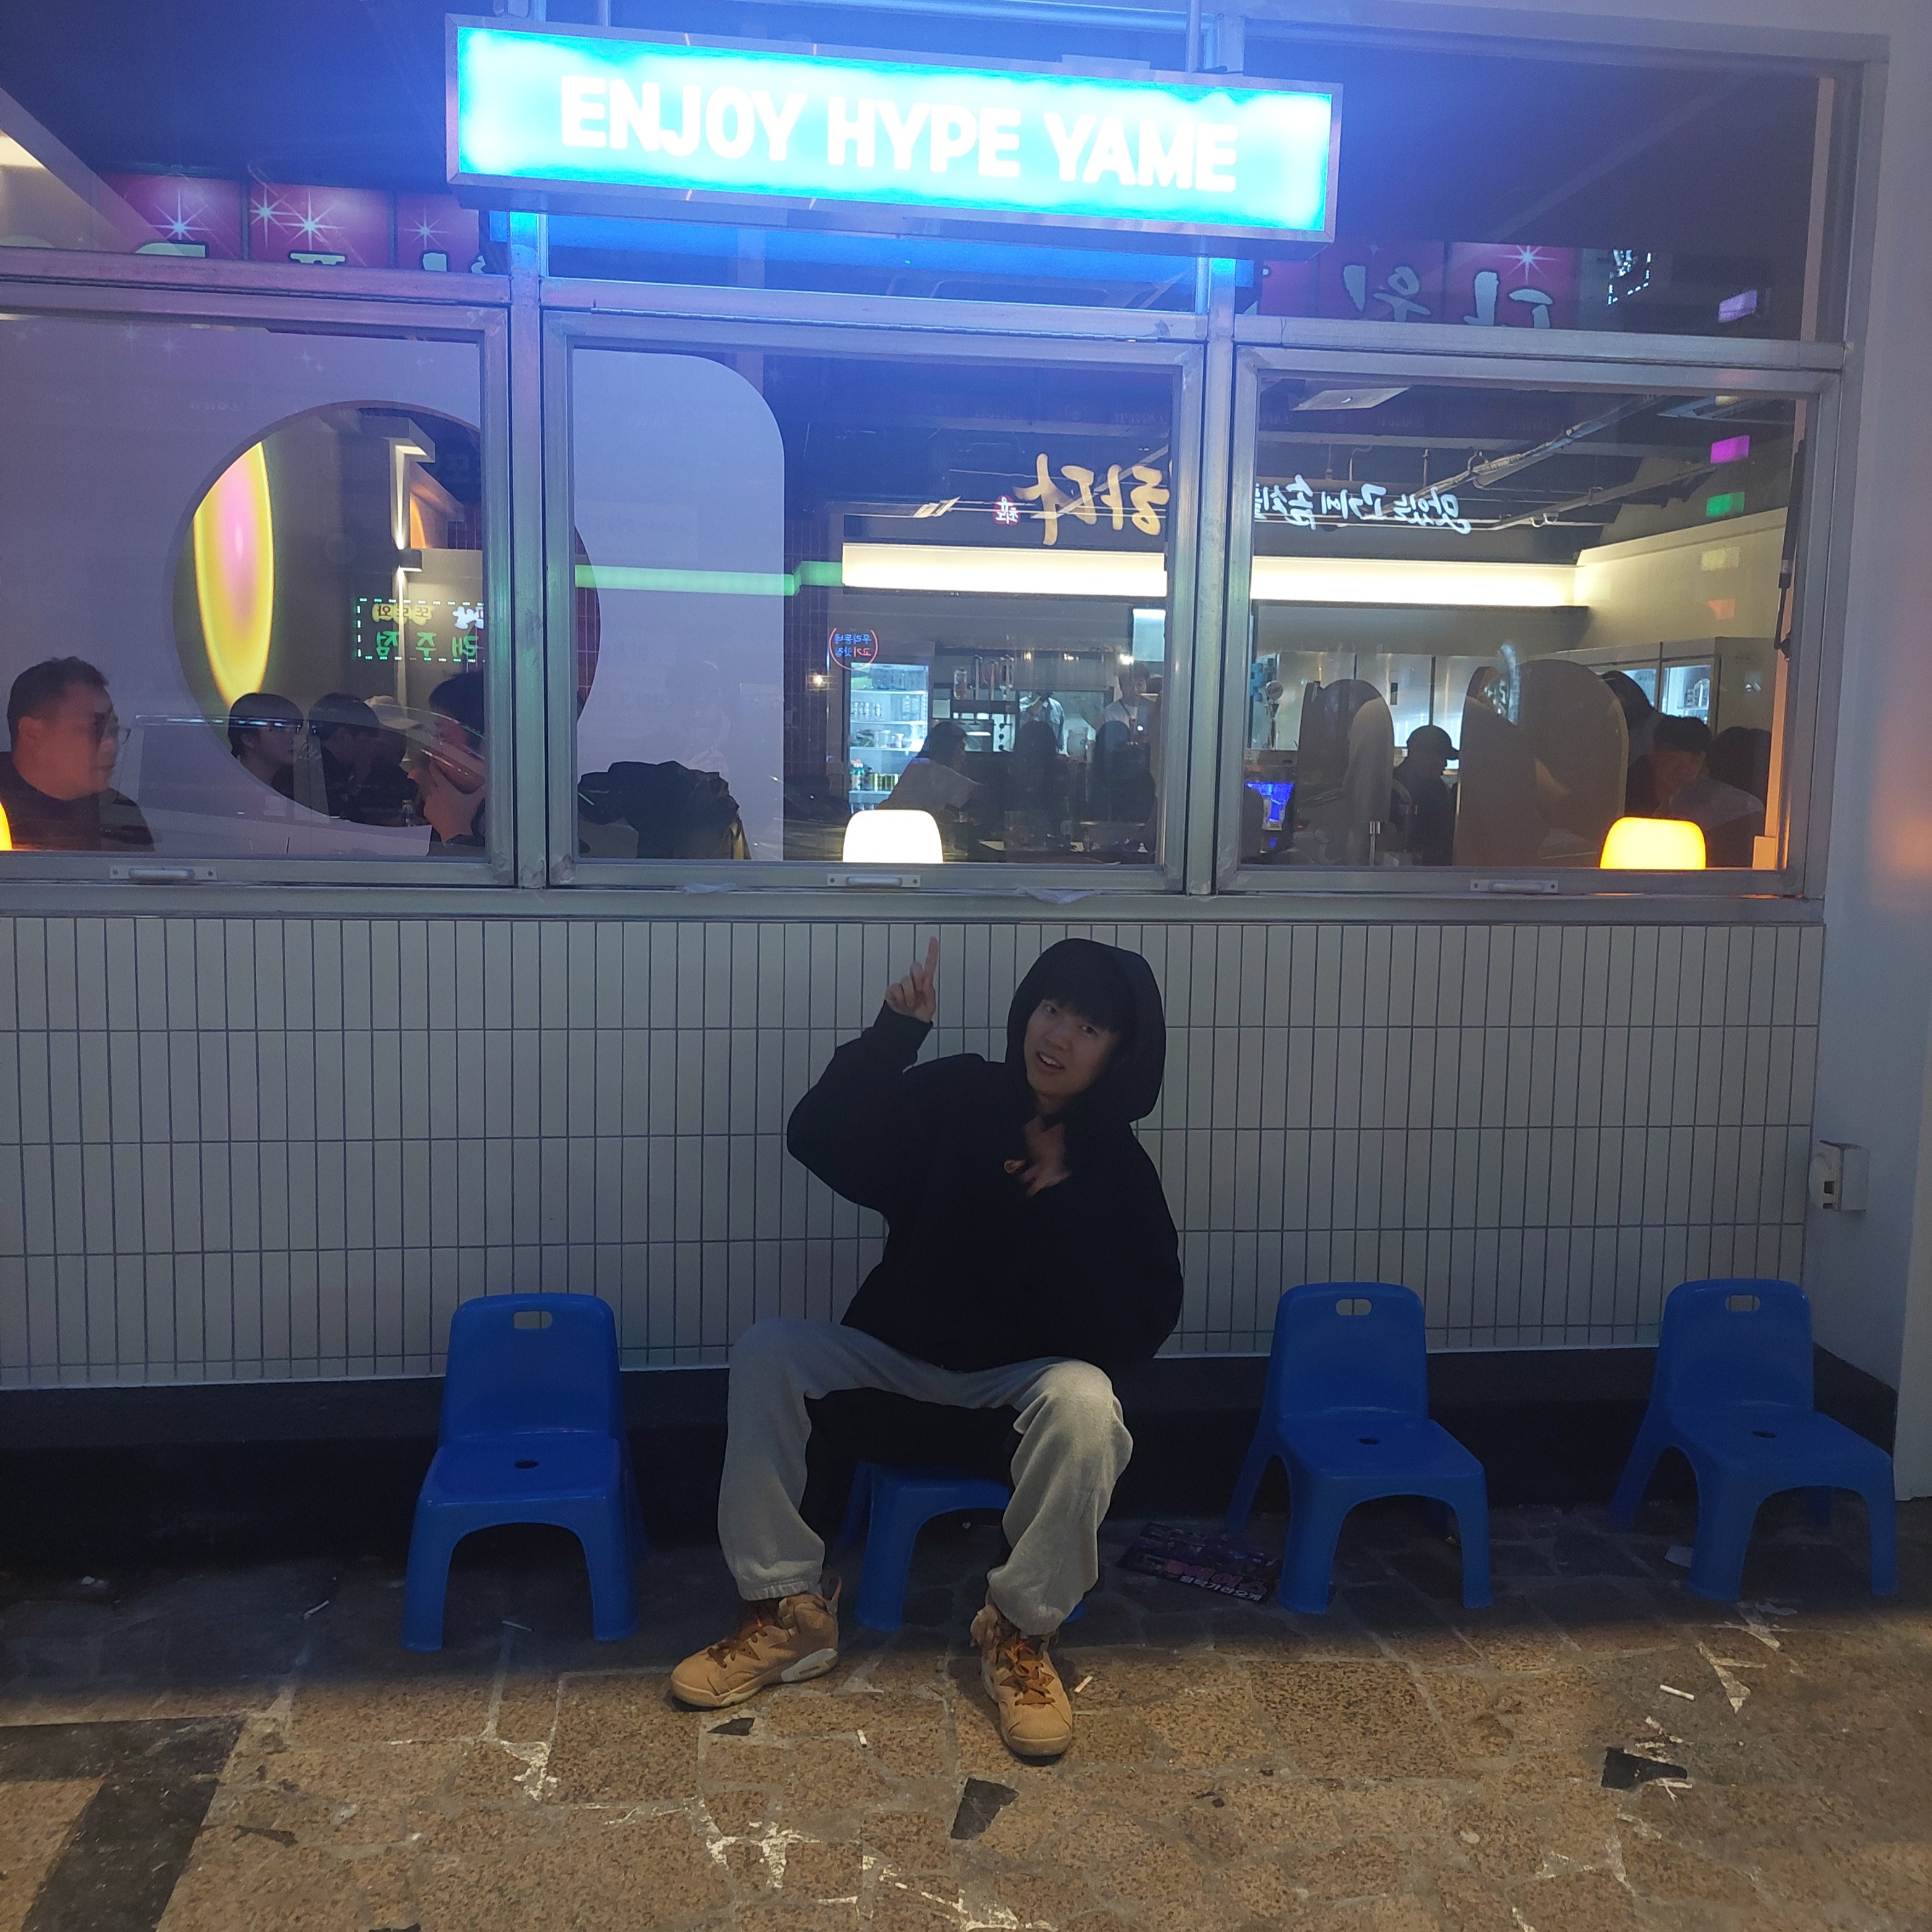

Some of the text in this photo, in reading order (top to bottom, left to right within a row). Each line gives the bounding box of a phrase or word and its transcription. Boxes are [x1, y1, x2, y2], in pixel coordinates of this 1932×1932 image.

[560, 76, 1239, 192] ENJOY HYPE YAME
